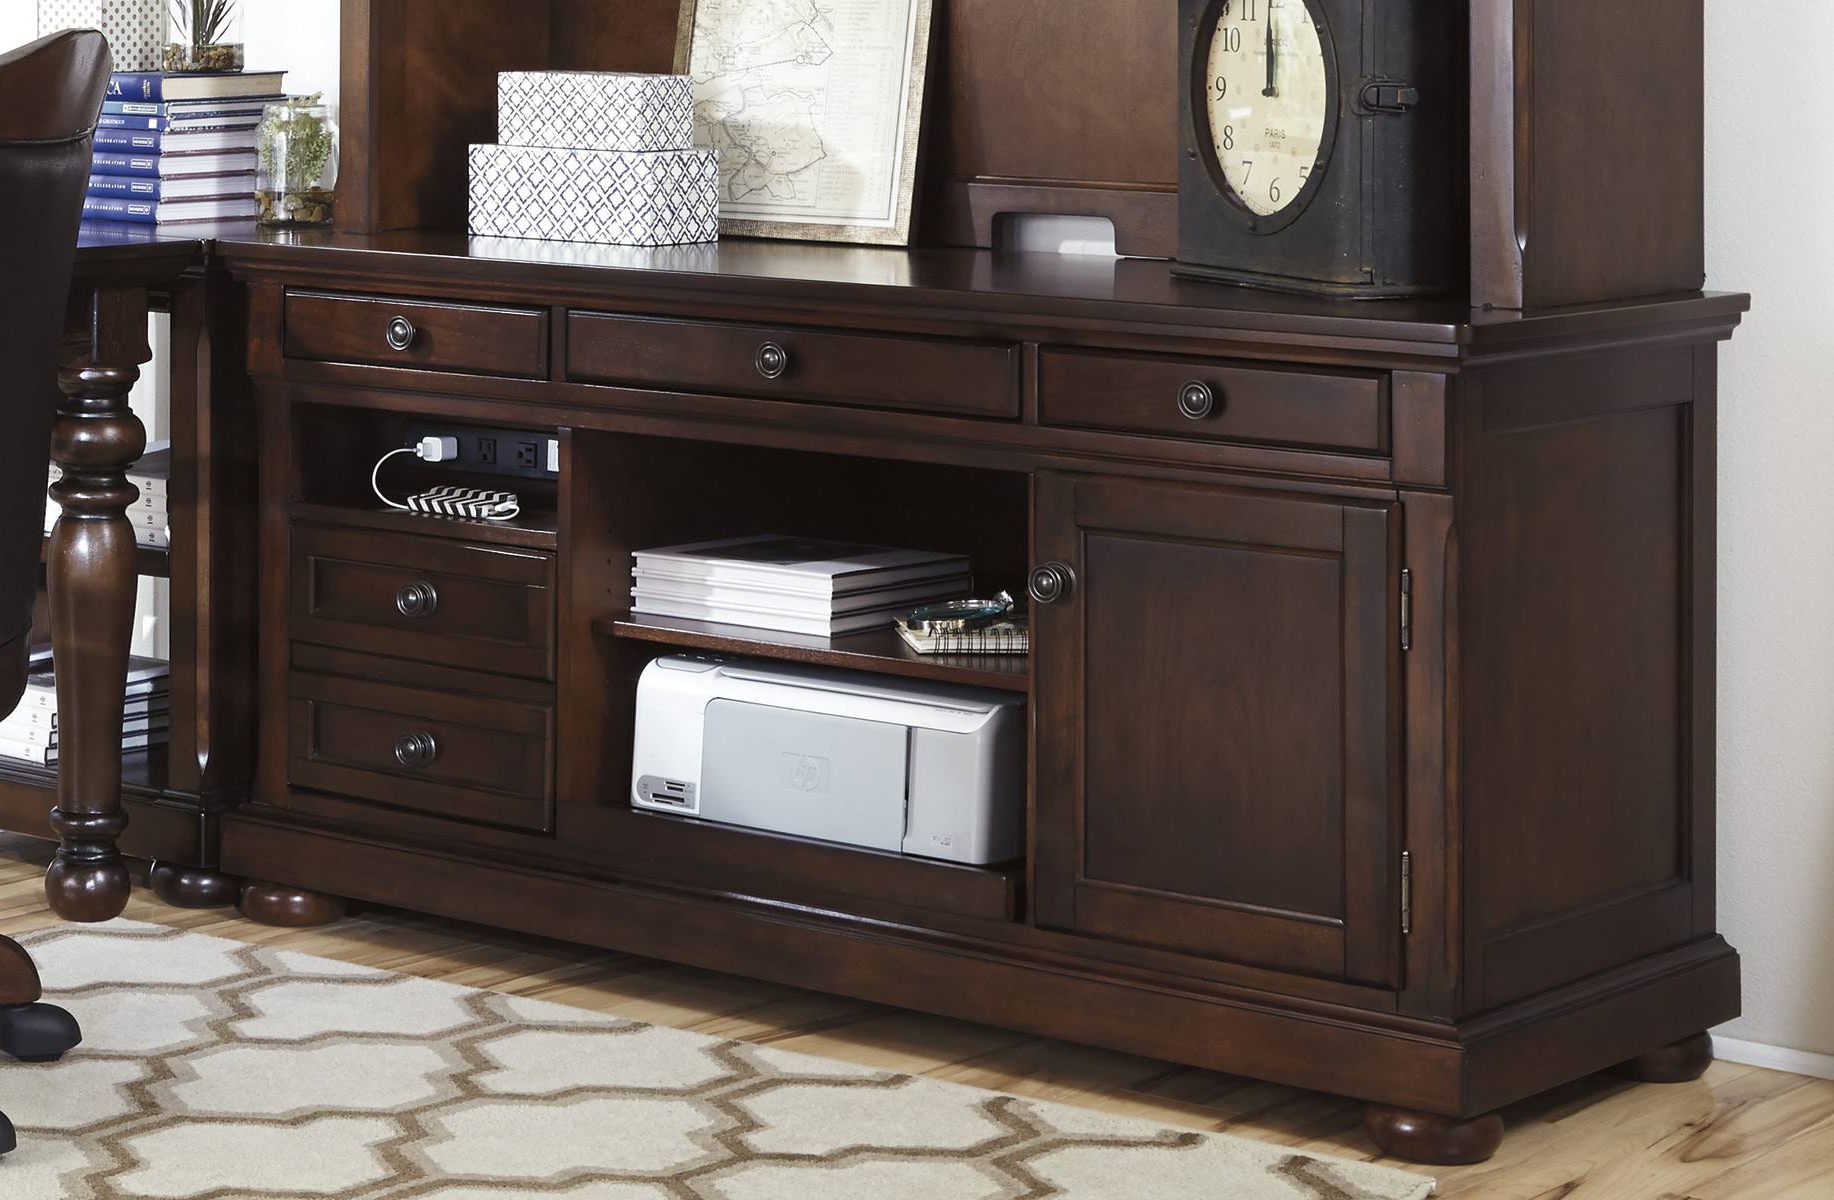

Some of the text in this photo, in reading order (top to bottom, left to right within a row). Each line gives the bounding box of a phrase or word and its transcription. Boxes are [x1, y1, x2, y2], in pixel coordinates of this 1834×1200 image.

[1222, 27, 1240, 53] 10
[1216, 76, 1226, 101] 9
[1223, 125, 1234, 150] 8
[1265, 128, 1286, 140] PARIS
[1242, 160, 1253, 185] 7
[1269, 177, 1280, 202] 6
